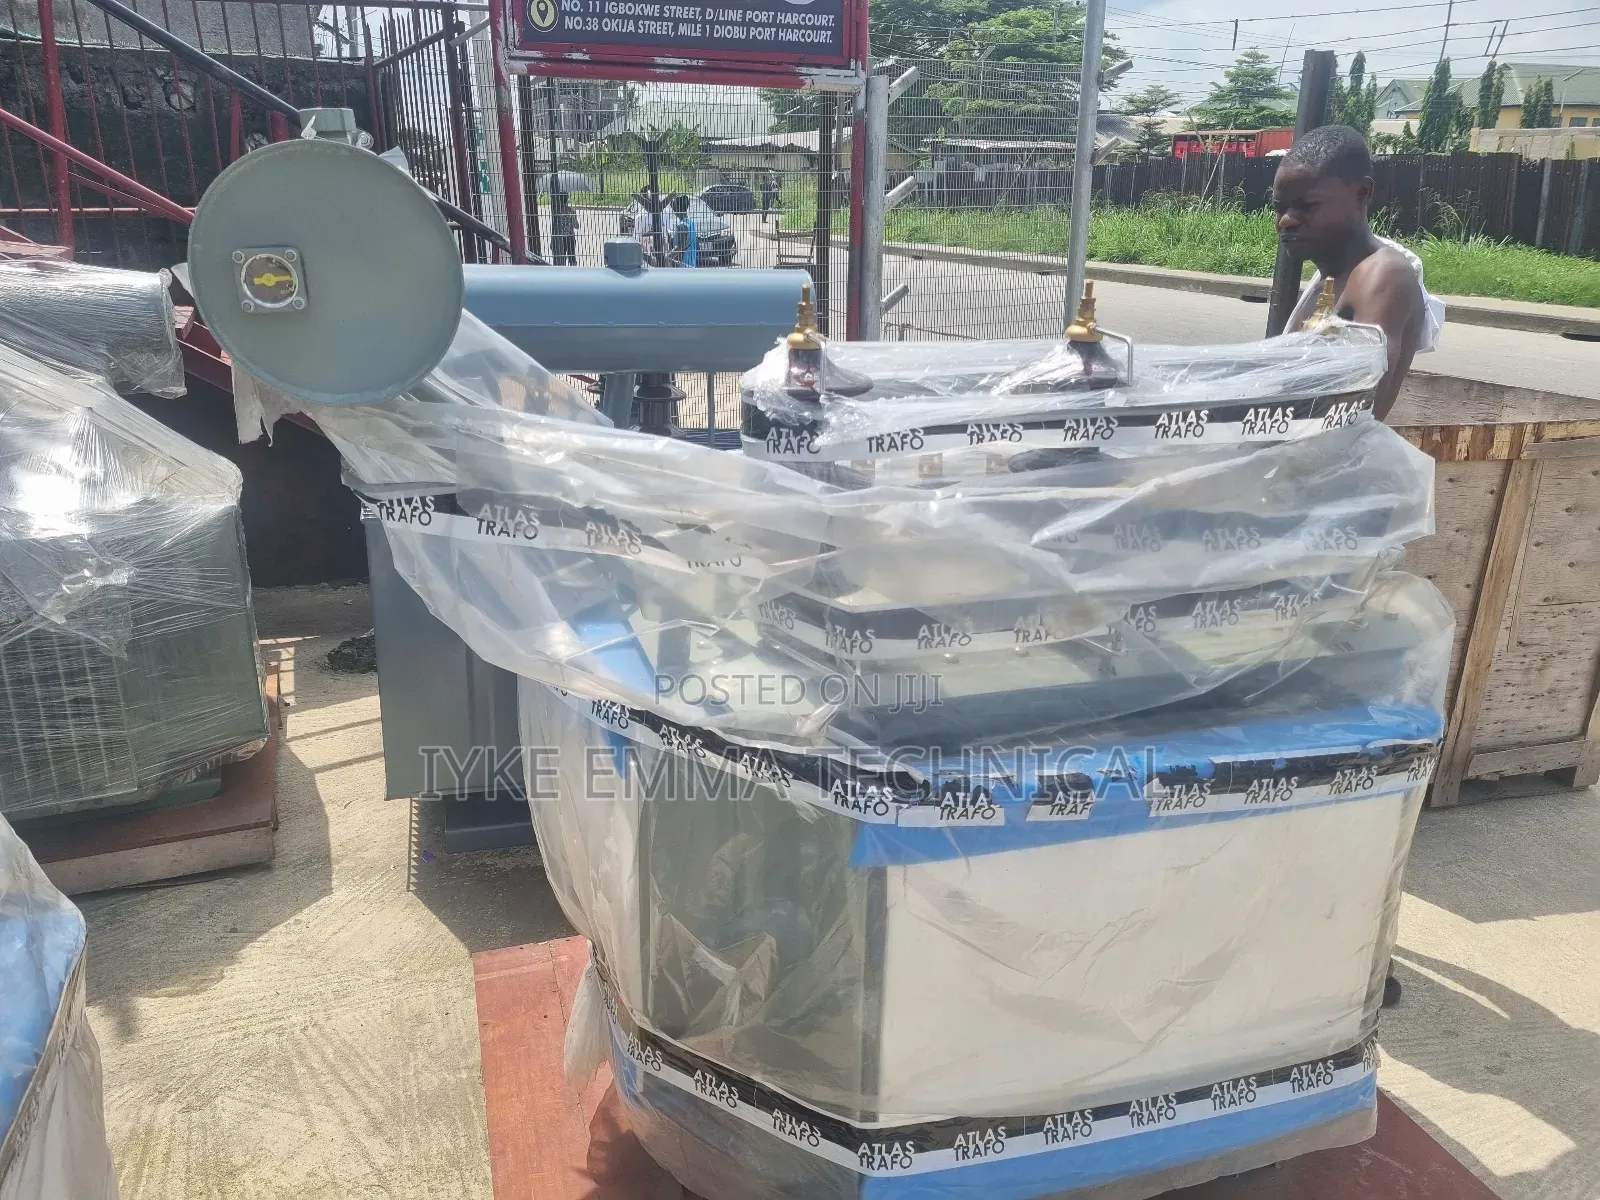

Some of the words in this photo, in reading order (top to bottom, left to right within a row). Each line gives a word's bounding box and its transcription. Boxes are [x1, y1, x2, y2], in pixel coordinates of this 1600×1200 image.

[561, 0, 584, 12] NO.
[588, 0, 600, 13] 11
[605, 2, 661, 17] IGBOKWE
[663, 5, 703, 21] STREET,
[706, 8, 743, 22] D/LINE
[746, 10, 775, 23] PORT
[776, 12, 835, 27] HARCOURT.
[564, 16, 599, 31] NO.38
[602, 18, 636, 32] OKIJA
[638, 20, 676, 37] STREET,
[678, 23, 702, 37] MILE
[705, 24, 710, 37] 1
[714, 25, 747, 39] DIOBU
[750, 27, 777, 41] PORT
[779, 28, 833, 43] HARCOURT.
[1155, 409, 1210, 427] ATLAS
[1243, 406, 1295, 424] ATLAS
[1063, 428, 1115, 442] TRAFO
[1154, 423, 1205, 439] TRAFO
[1241, 420, 1289, 435] TRAFO
[766, 438, 822, 455] TRAFO
[867, 433, 925, 453] TRAFO
[377, 504, 433, 527] TRAFO
[479, 503, 541, 526] ATLAS
[476, 518, 539, 541] TRAFO
[1192, 597, 1243, 617] ATLAS
[917, 631, 972, 650] TRAFO
[591, 700, 629, 730] TRAFO
[659, 723, 705, 746] ATLAS
[1247, 776, 1299, 794] ATLAS
[1331, 765, 1379, 785] ATLAS
[830, 778, 894, 802] ATLAS
[1164, 782, 1212, 799] ATLAS
[1243, 788, 1293, 804] TRAFO
[1328, 777, 1374, 796] TRAFO
[833, 792, 890, 817] TRAFO
[939, 804, 996, 821] TRAFO
[1155, 796, 1207, 812] TRAFO
[627, 1030, 663, 1064] ATLAS
[1290, 1059, 1335, 1081] ATLAS
[693, 1069, 739, 1100] ATLAS
[693, 1077, 738, 1108] TRAFO
[1211, 1076, 1257, 1099] ATLAS
[1290, 1071, 1334, 1094] TRAFO
[1128, 1092, 1177, 1116] ATLAS
[1211, 1089, 1257, 1111] TRAFO
[772, 1108, 822, 1139] ATLAS
[1043, 1108, 1093, 1131] ATLAS
[1128, 1105, 1177, 1128] TRAFO
[771, 1115, 820, 1147] TRAFO
[953, 1126, 1007, 1148] ATLAS
[1043, 1121, 1093, 1145] TRAFO
[857, 1140, 915, 1157] ATLAS
[953, 1139, 1005, 1162] TRAFO
[858, 1152, 913, 1171] TRAFO
